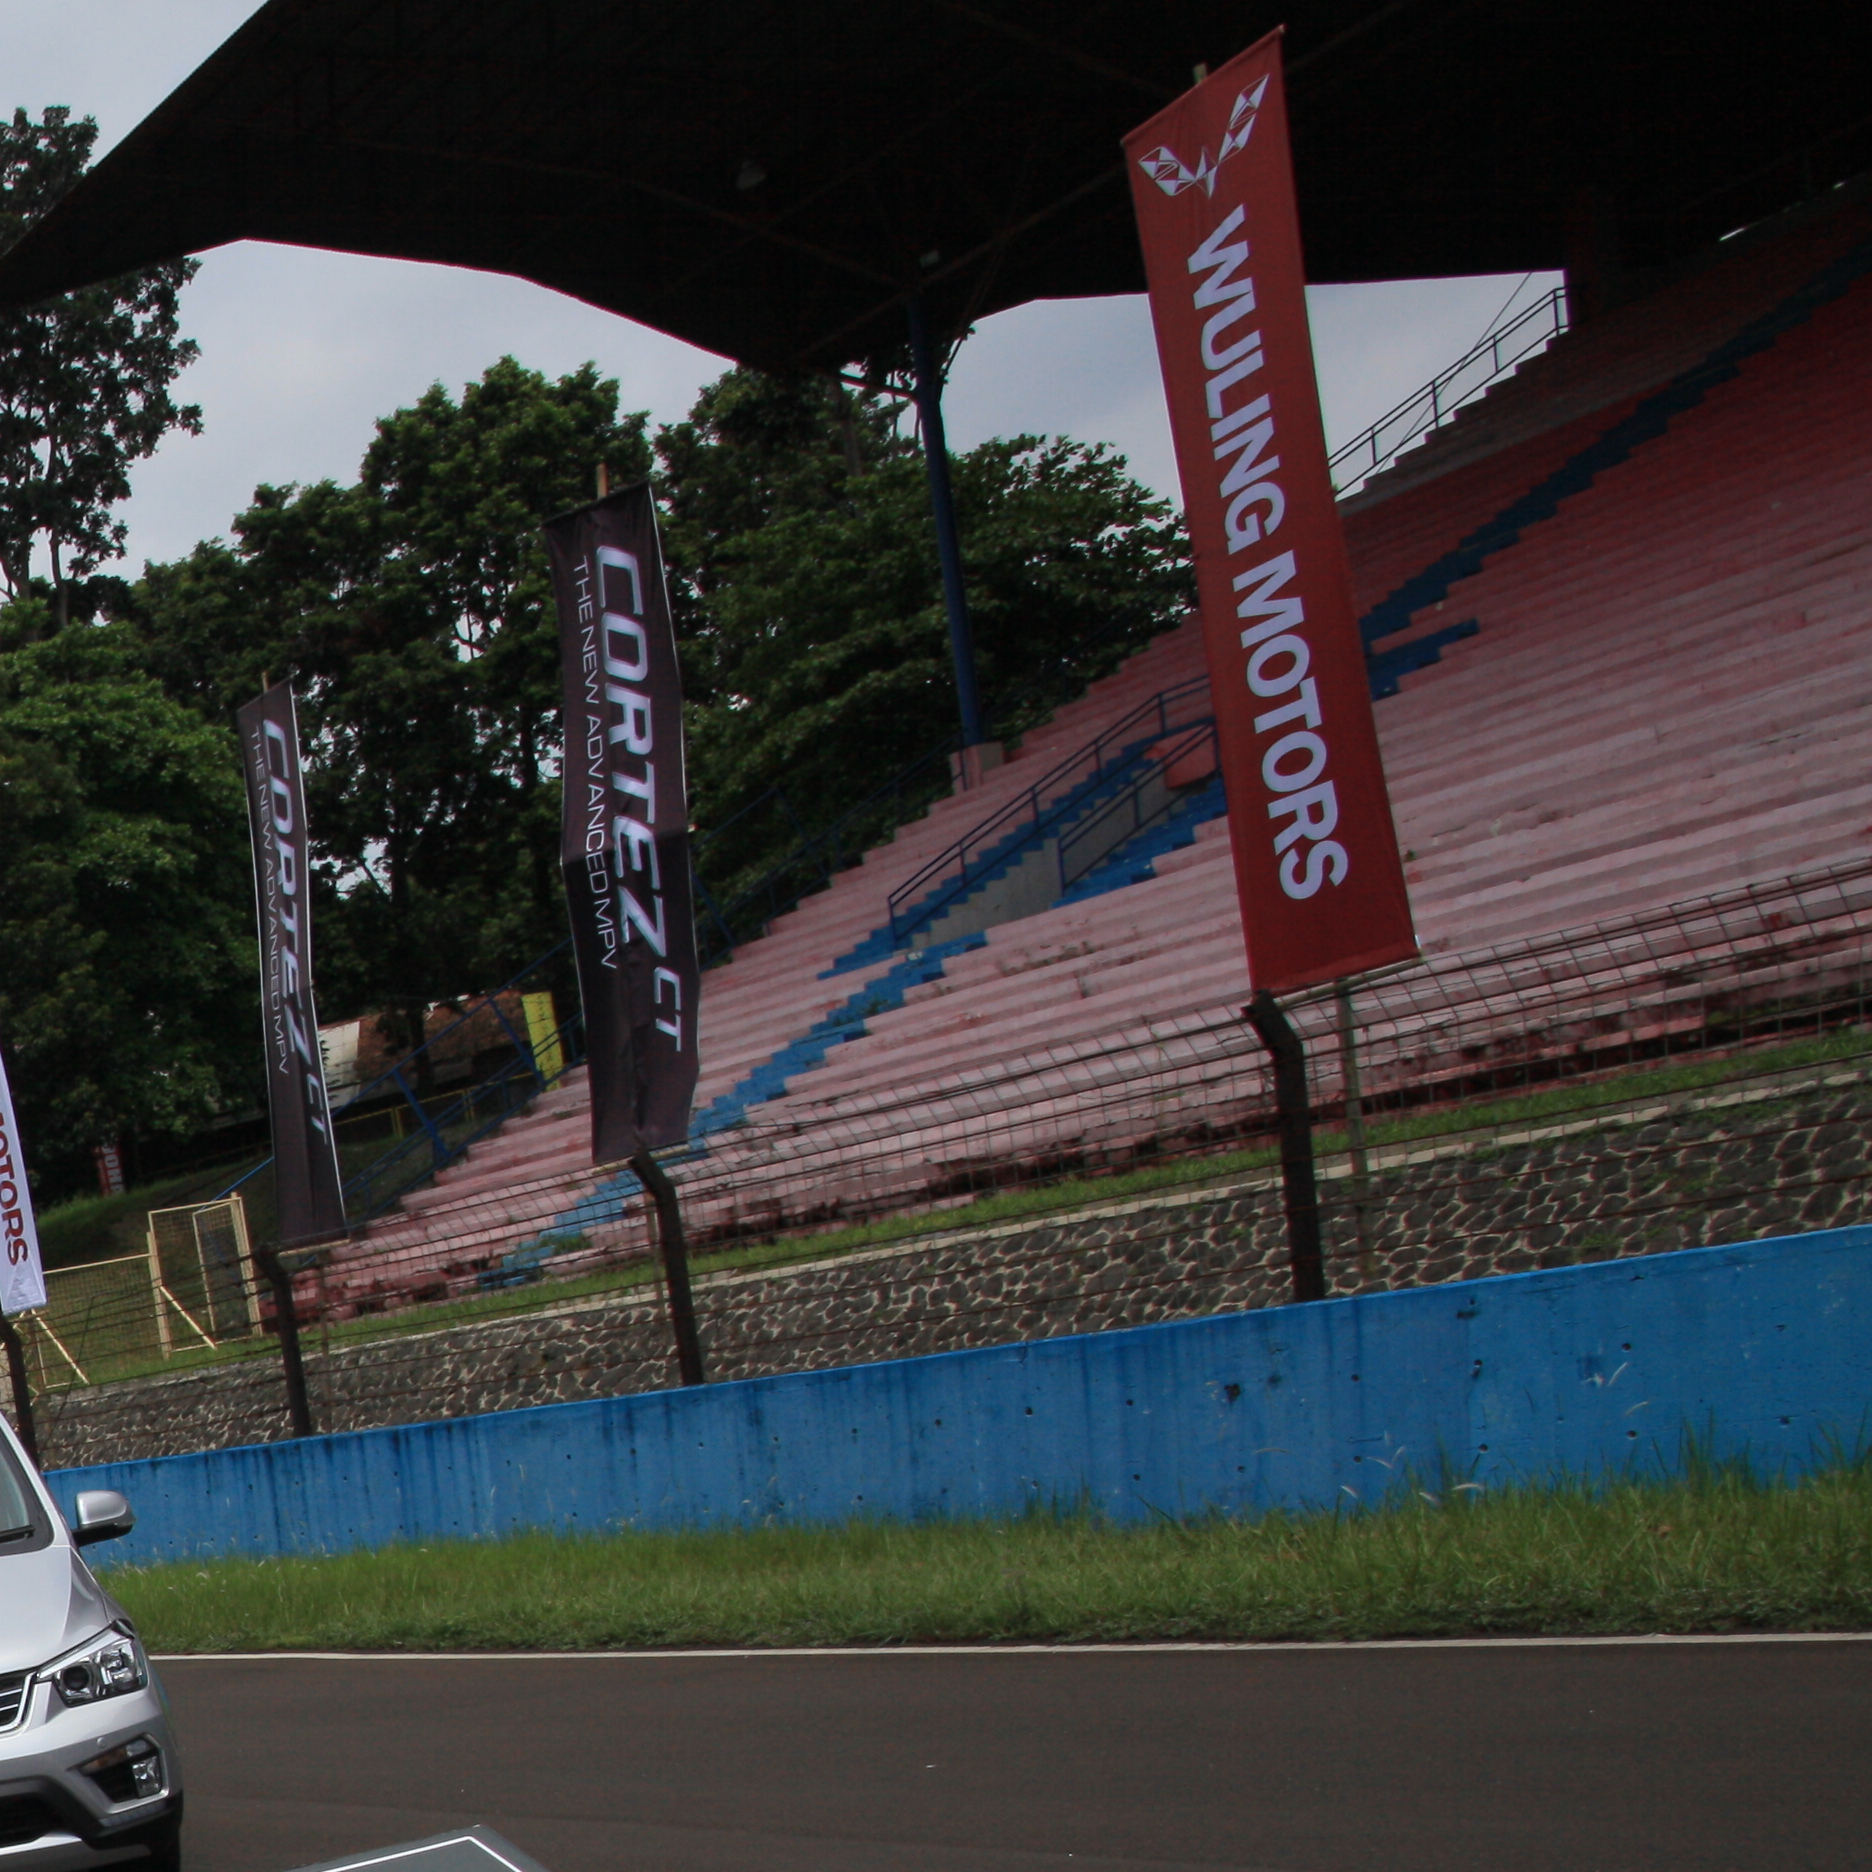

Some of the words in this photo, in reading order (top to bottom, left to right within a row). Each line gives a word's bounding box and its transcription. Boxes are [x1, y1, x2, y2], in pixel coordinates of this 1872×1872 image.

[1187, 203, 1287, 555] WULING
[573, 555, 594, 624] THE
[580, 625, 600, 704] NEW
[250, 725, 267, 782] THE
[1232, 551, 1349, 901] MOTORS
[258, 783, 272, 851] NEW
[585, 714, 608, 893] ADVANCED
[596, 545, 667, 957] CORTEZ
[654, 966, 682, 1052] CT
[263, 718, 312, 1066] CORTEZ
[265, 858, 280, 1011] ADVANCED
[594, 897, 617, 969] MPV
[273, 1014, 289, 1075] MPV
